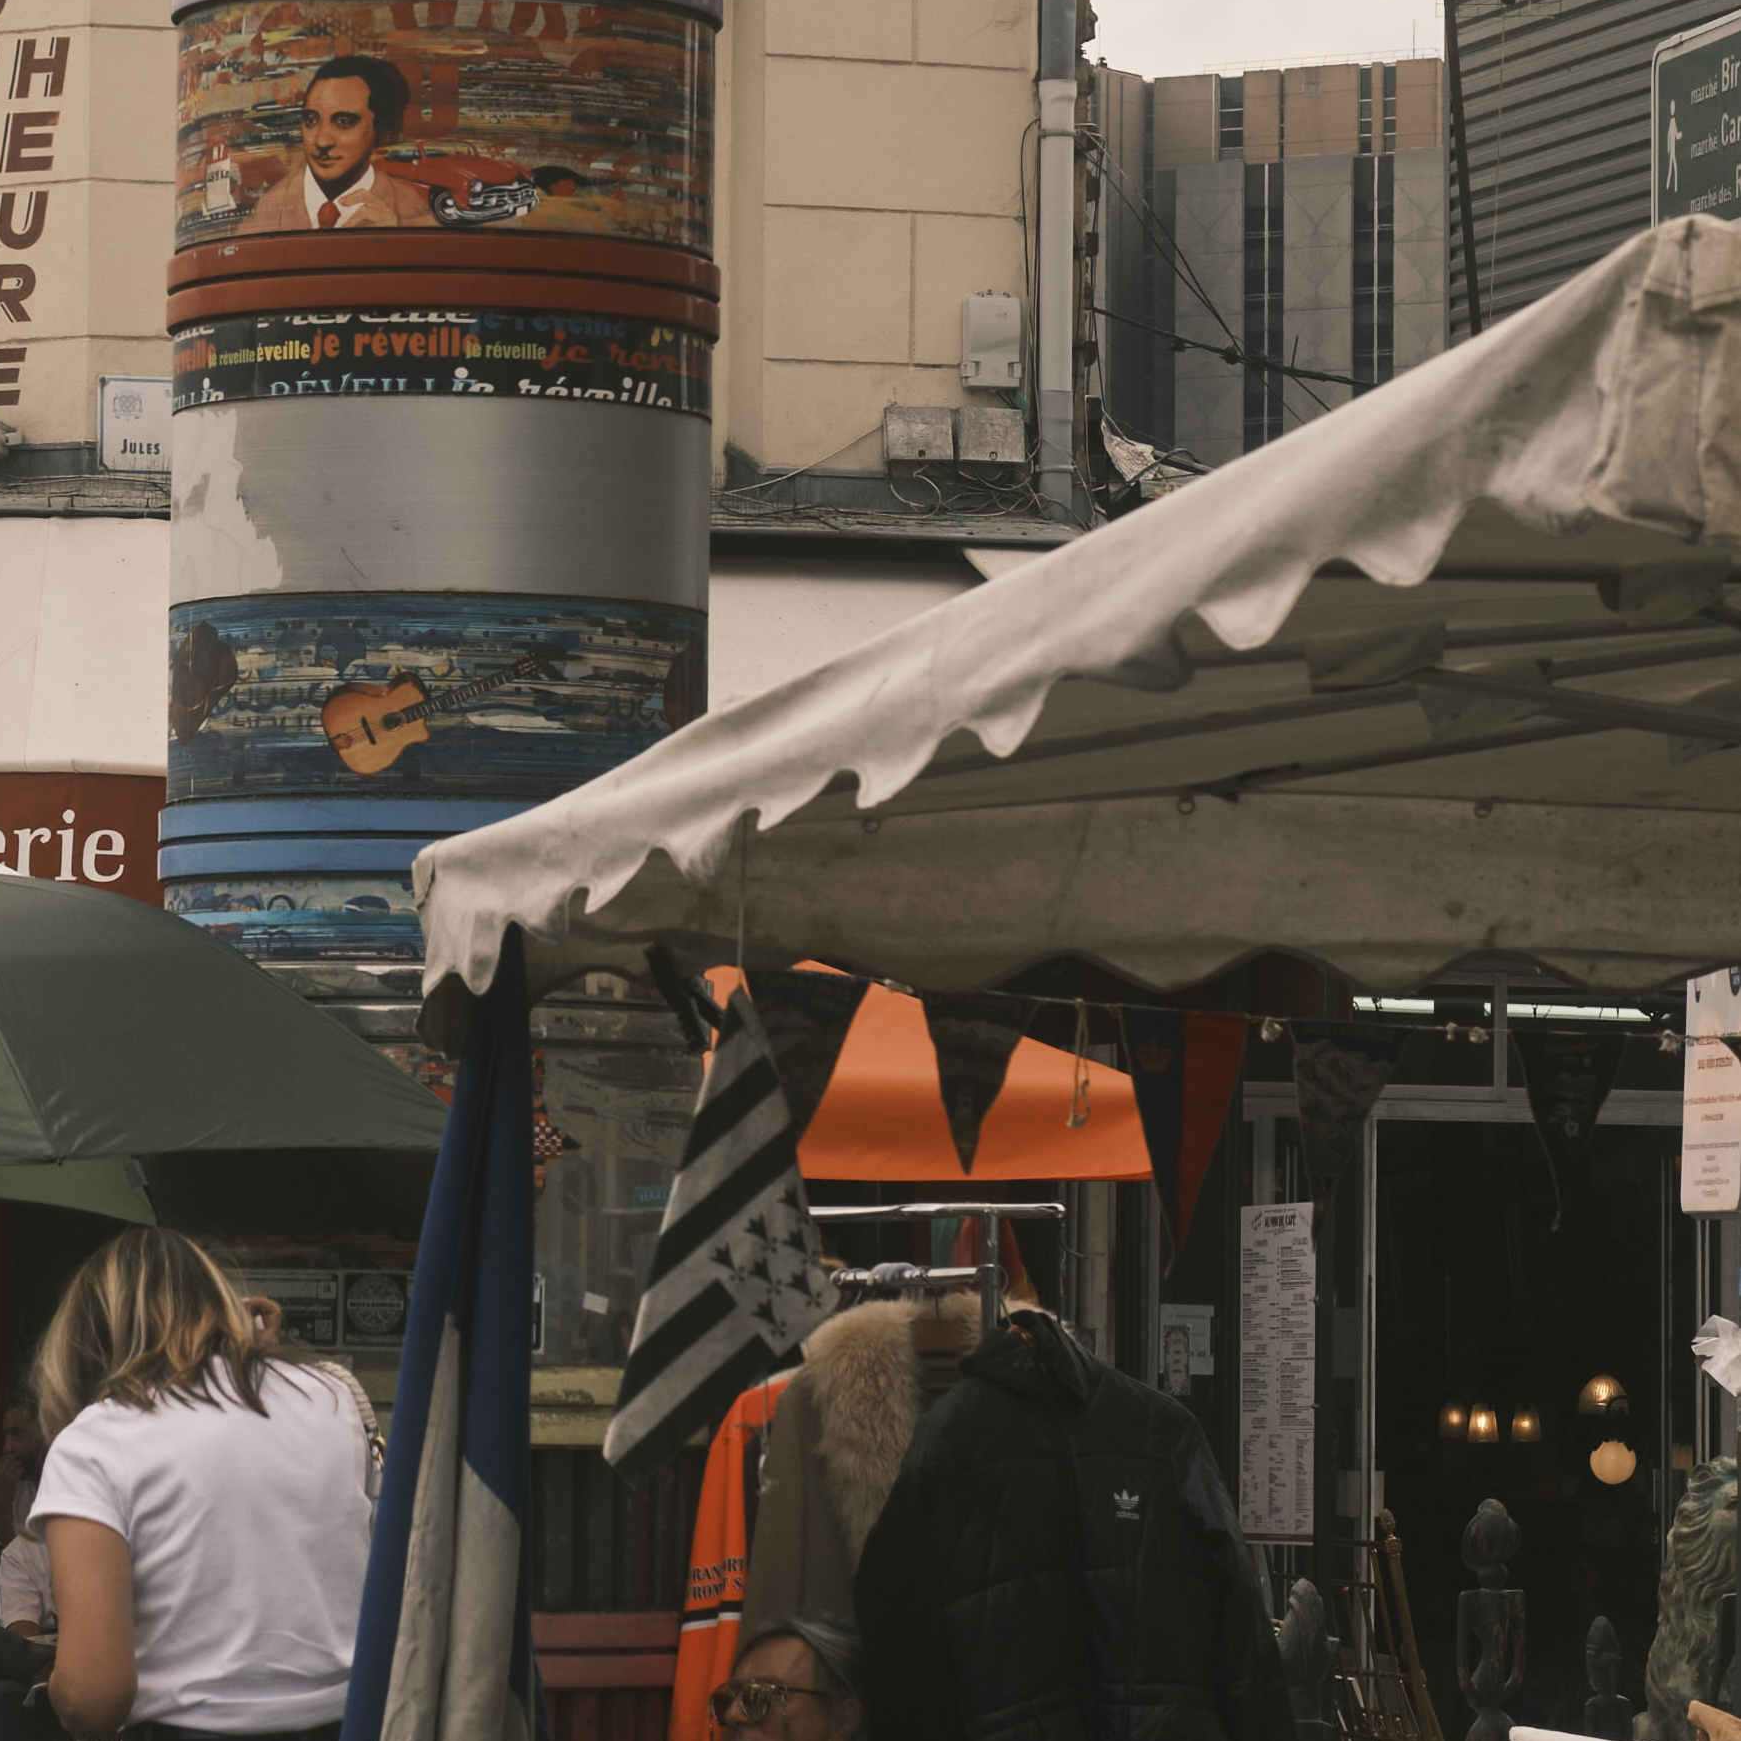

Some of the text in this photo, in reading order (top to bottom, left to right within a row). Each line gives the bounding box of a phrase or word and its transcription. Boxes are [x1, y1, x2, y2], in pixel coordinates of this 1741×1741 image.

[1690, 74, 1719, 106] marché
[1690, 128, 1719, 160] marché
[1690, 183, 1733, 214] marché des
[311, 326, 481, 365] je réveille
[486, 341, 547, 361] réveille
[120, 438, 161, 455] JULES
